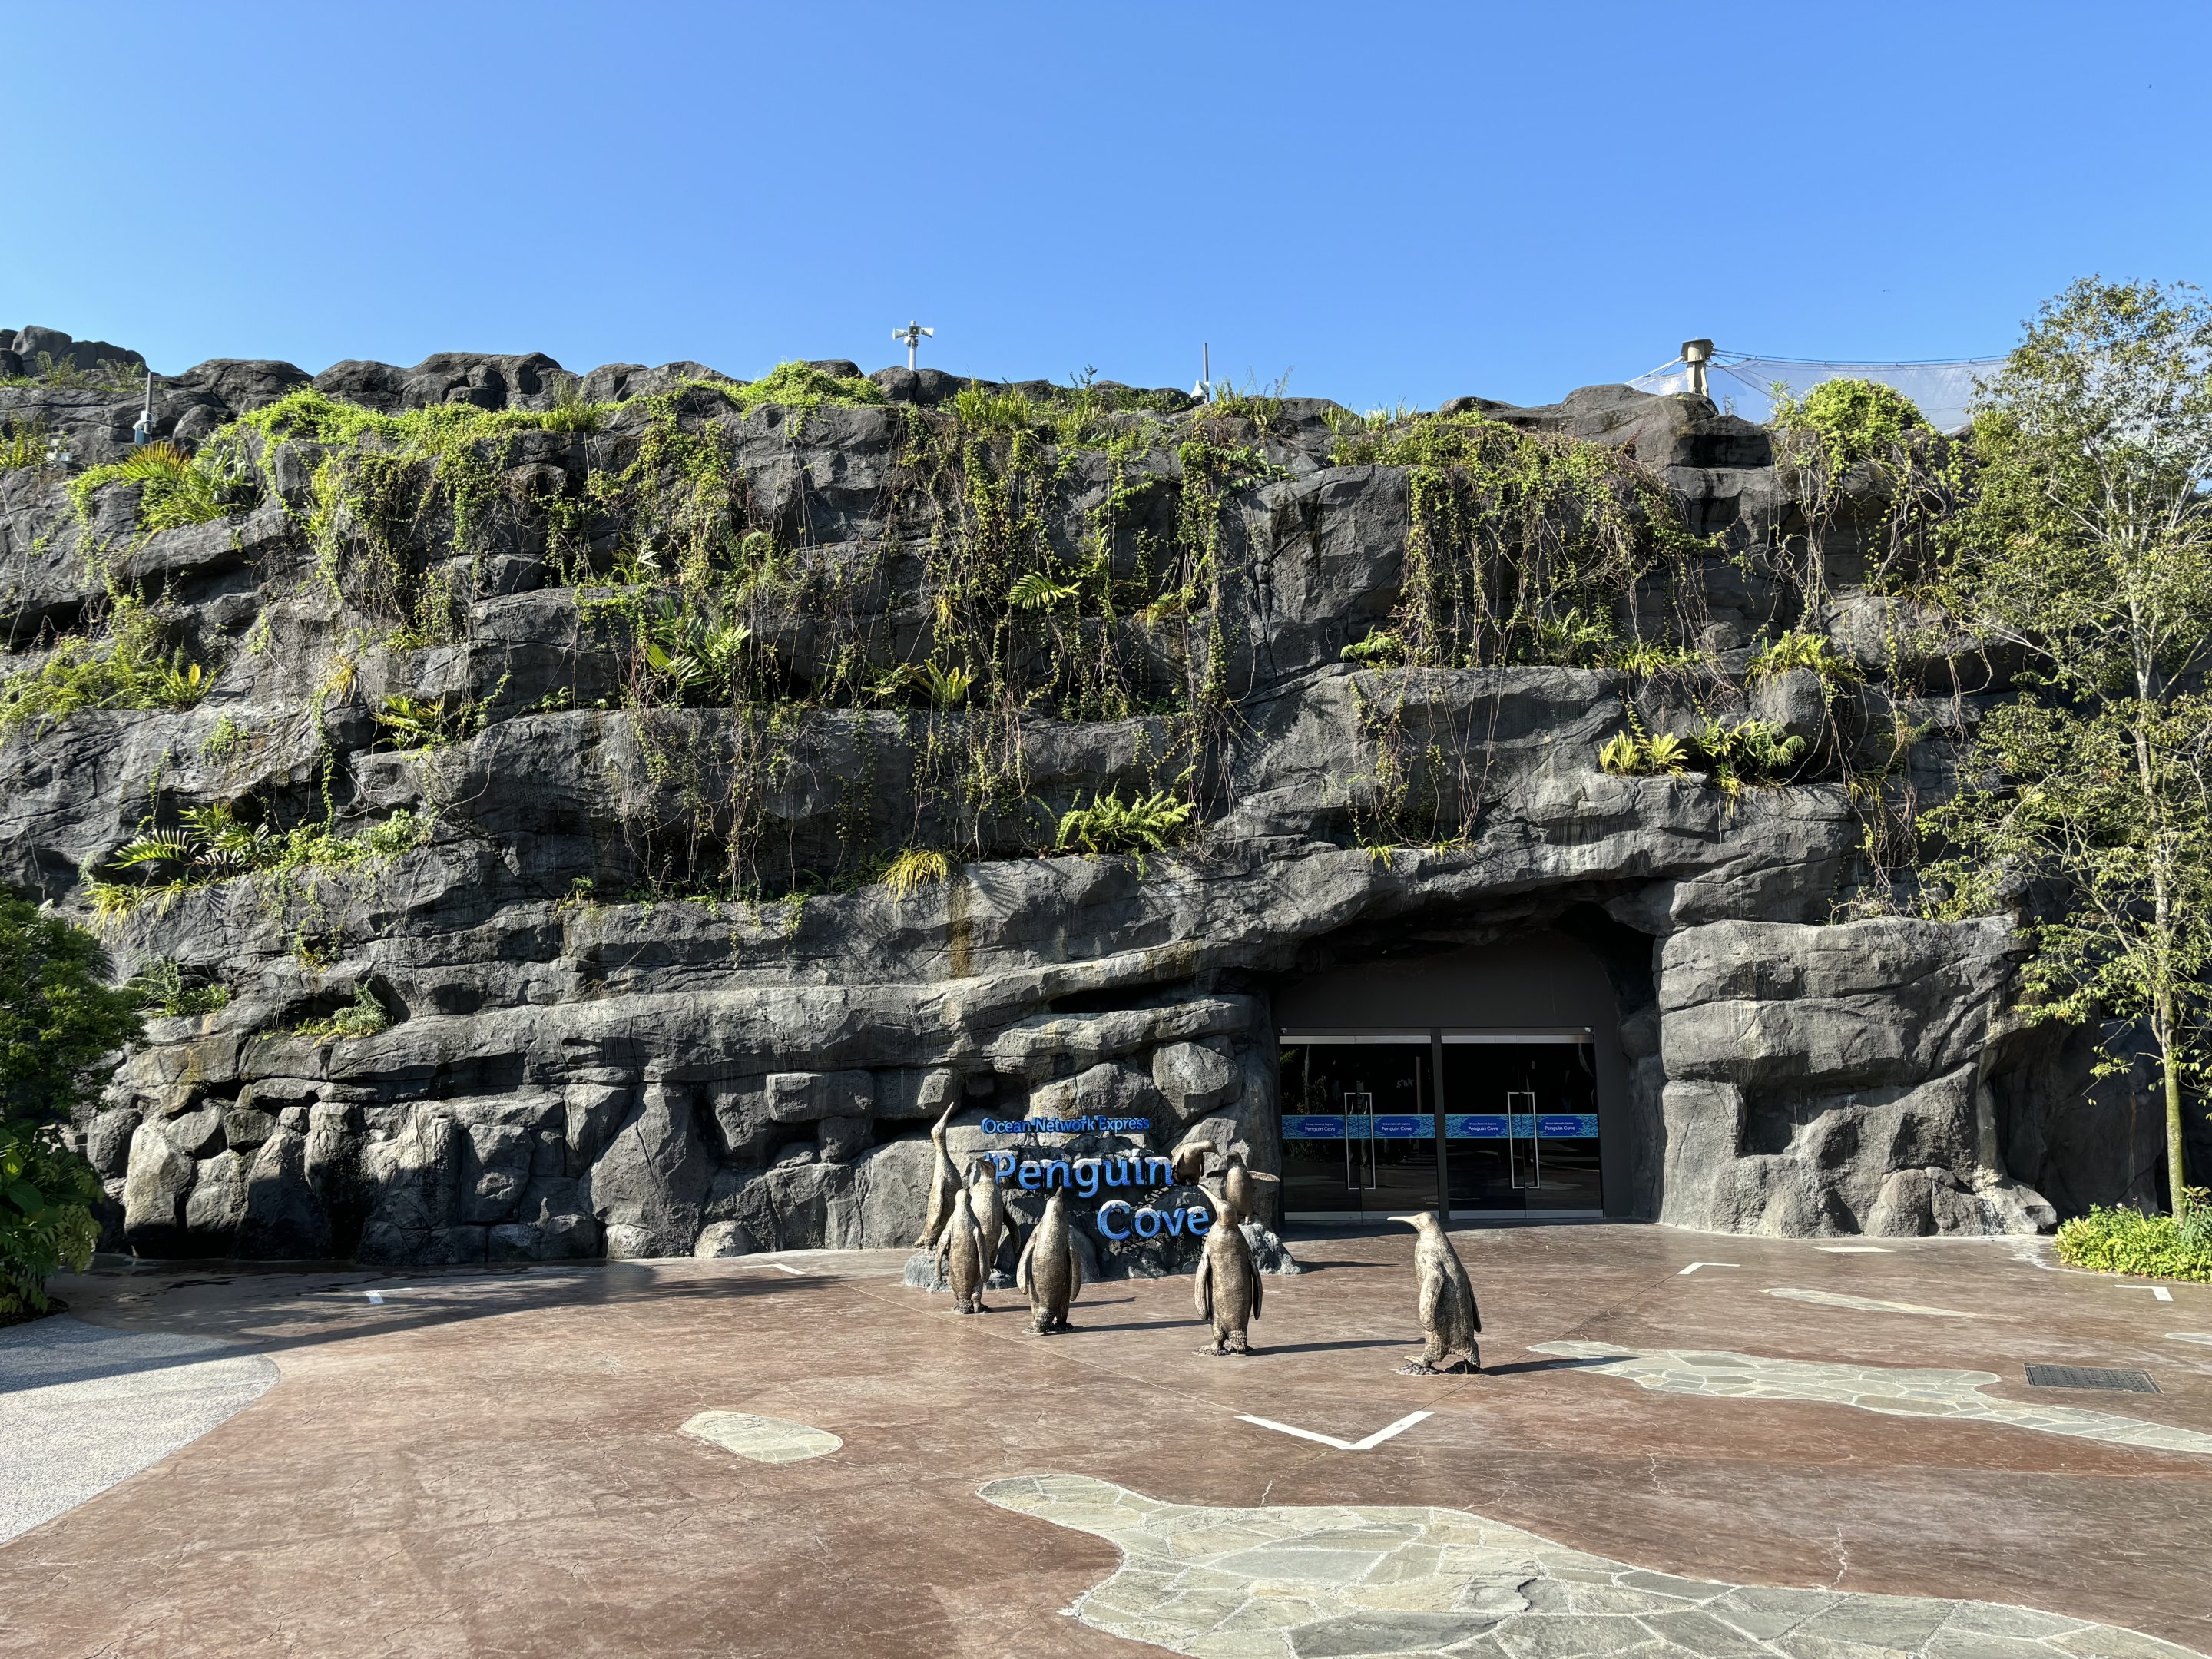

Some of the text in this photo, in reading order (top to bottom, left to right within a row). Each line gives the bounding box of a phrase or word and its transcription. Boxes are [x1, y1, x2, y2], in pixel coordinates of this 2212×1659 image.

[981, 1115, 1150, 1134] Ocean Network Express
[986, 1150, 1174, 1198] Penguin
[1097, 1200, 1210, 1240] Cove
